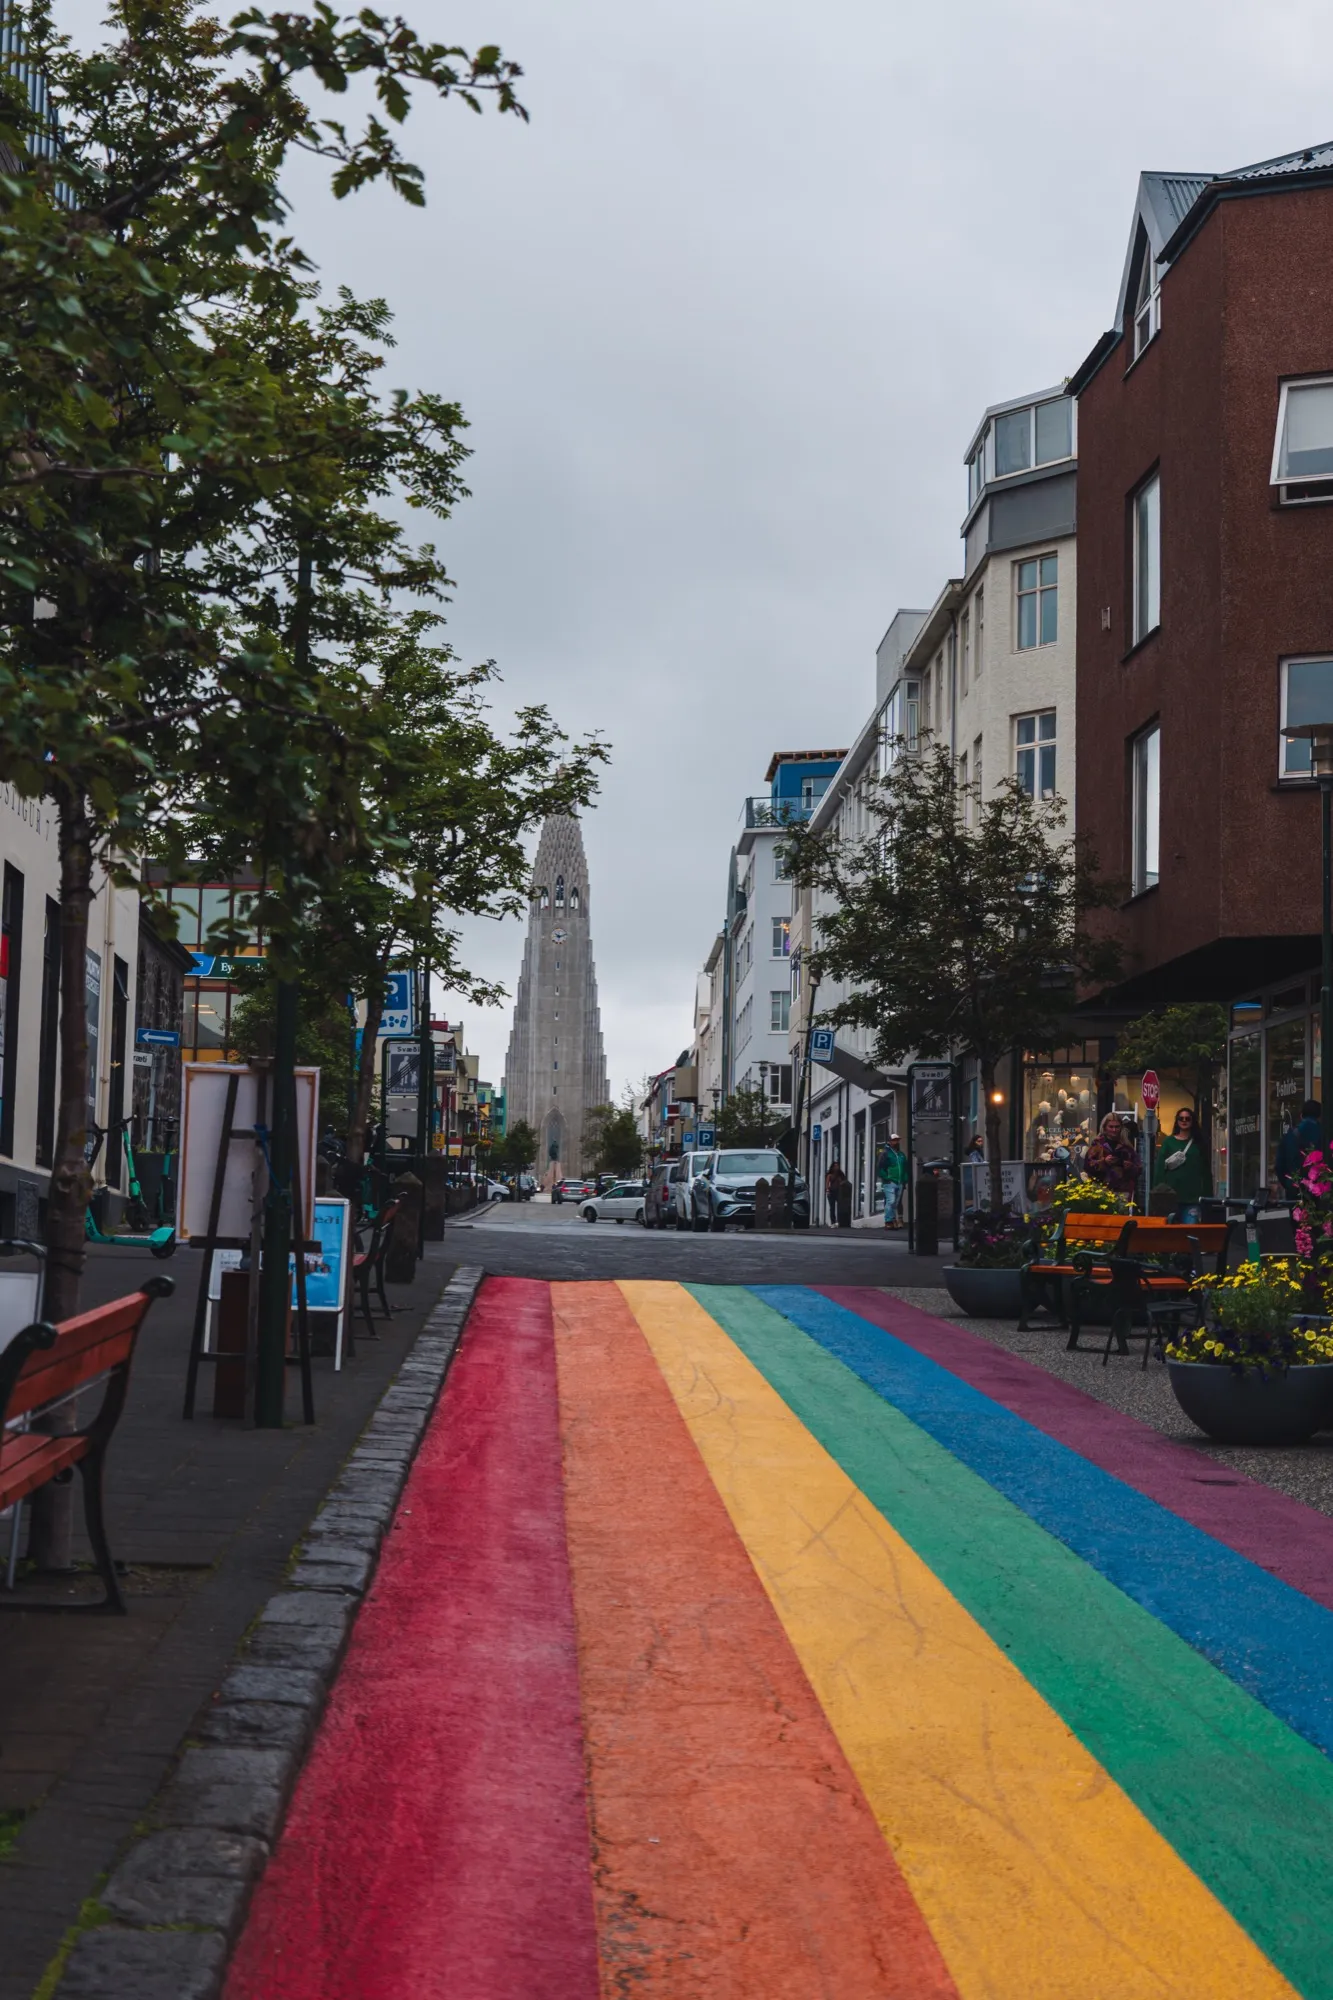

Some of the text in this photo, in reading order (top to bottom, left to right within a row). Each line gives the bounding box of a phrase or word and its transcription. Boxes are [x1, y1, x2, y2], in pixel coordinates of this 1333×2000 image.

[817, 1034, 828, 1047] P
[133, 1054, 148, 1063] ræti
[1143, 1083, 1159, 1098] STOP
[702, 1133, 711, 1144] P
